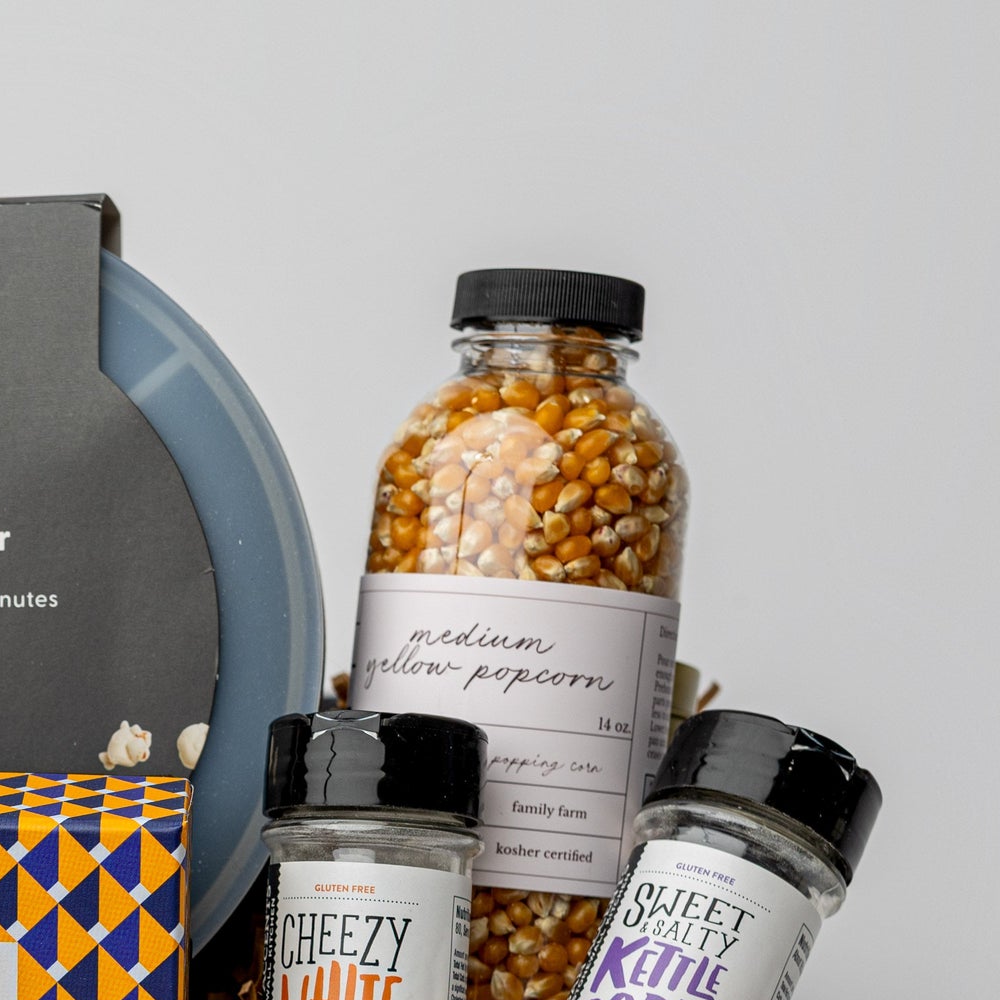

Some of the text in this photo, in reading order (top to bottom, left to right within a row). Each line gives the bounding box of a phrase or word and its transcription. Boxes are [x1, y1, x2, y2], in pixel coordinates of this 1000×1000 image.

[409, 622, 556, 655] medium
[365, 643, 614, 693] yellow popcorn
[597, 716, 632, 734] 14 oz.
[488, 754, 603, 777] popping corn
[511, 800, 588, 820] family farm
[495, 841, 593, 864] kosher certified
[675, 861, 736, 886] GLUTEN FREE
[314, 883, 376, 895] GLUTEN FREE
[622, 881, 755, 934] SWEET
[280, 912, 412, 972] CHEEZY
[639, 919, 740, 960] & SALTY
